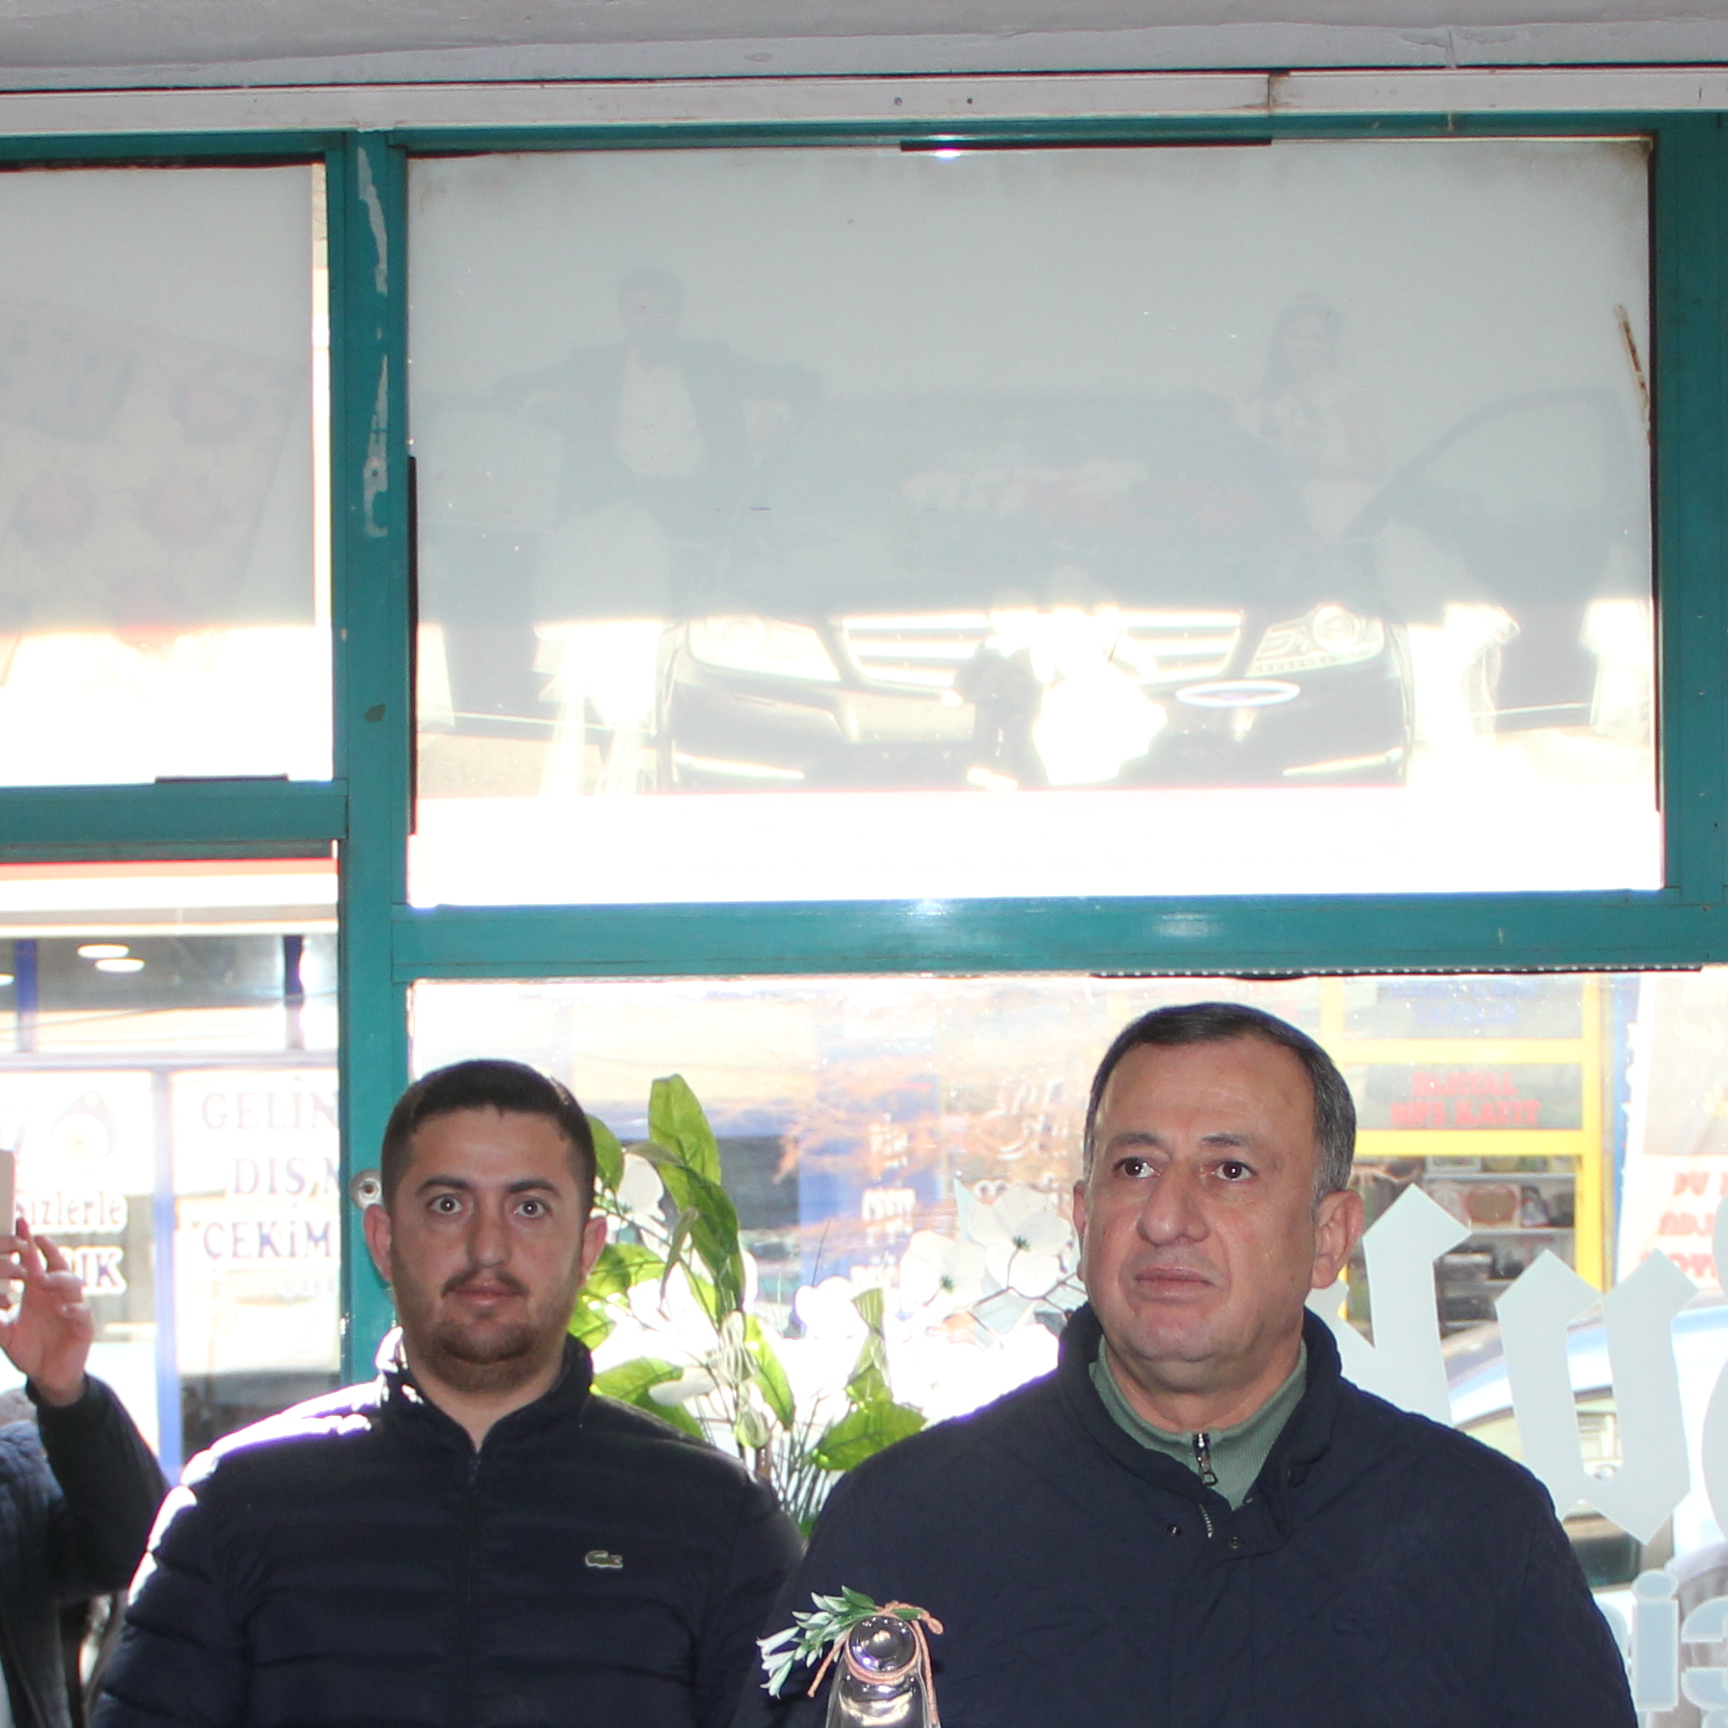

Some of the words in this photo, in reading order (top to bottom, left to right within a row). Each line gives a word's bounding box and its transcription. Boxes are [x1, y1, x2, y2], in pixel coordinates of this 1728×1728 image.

[201, 1076, 338, 1130] GELİN
[233, 1157, 306, 1208] DIŞ
[202, 1220, 333, 1272] ÇEKİM
